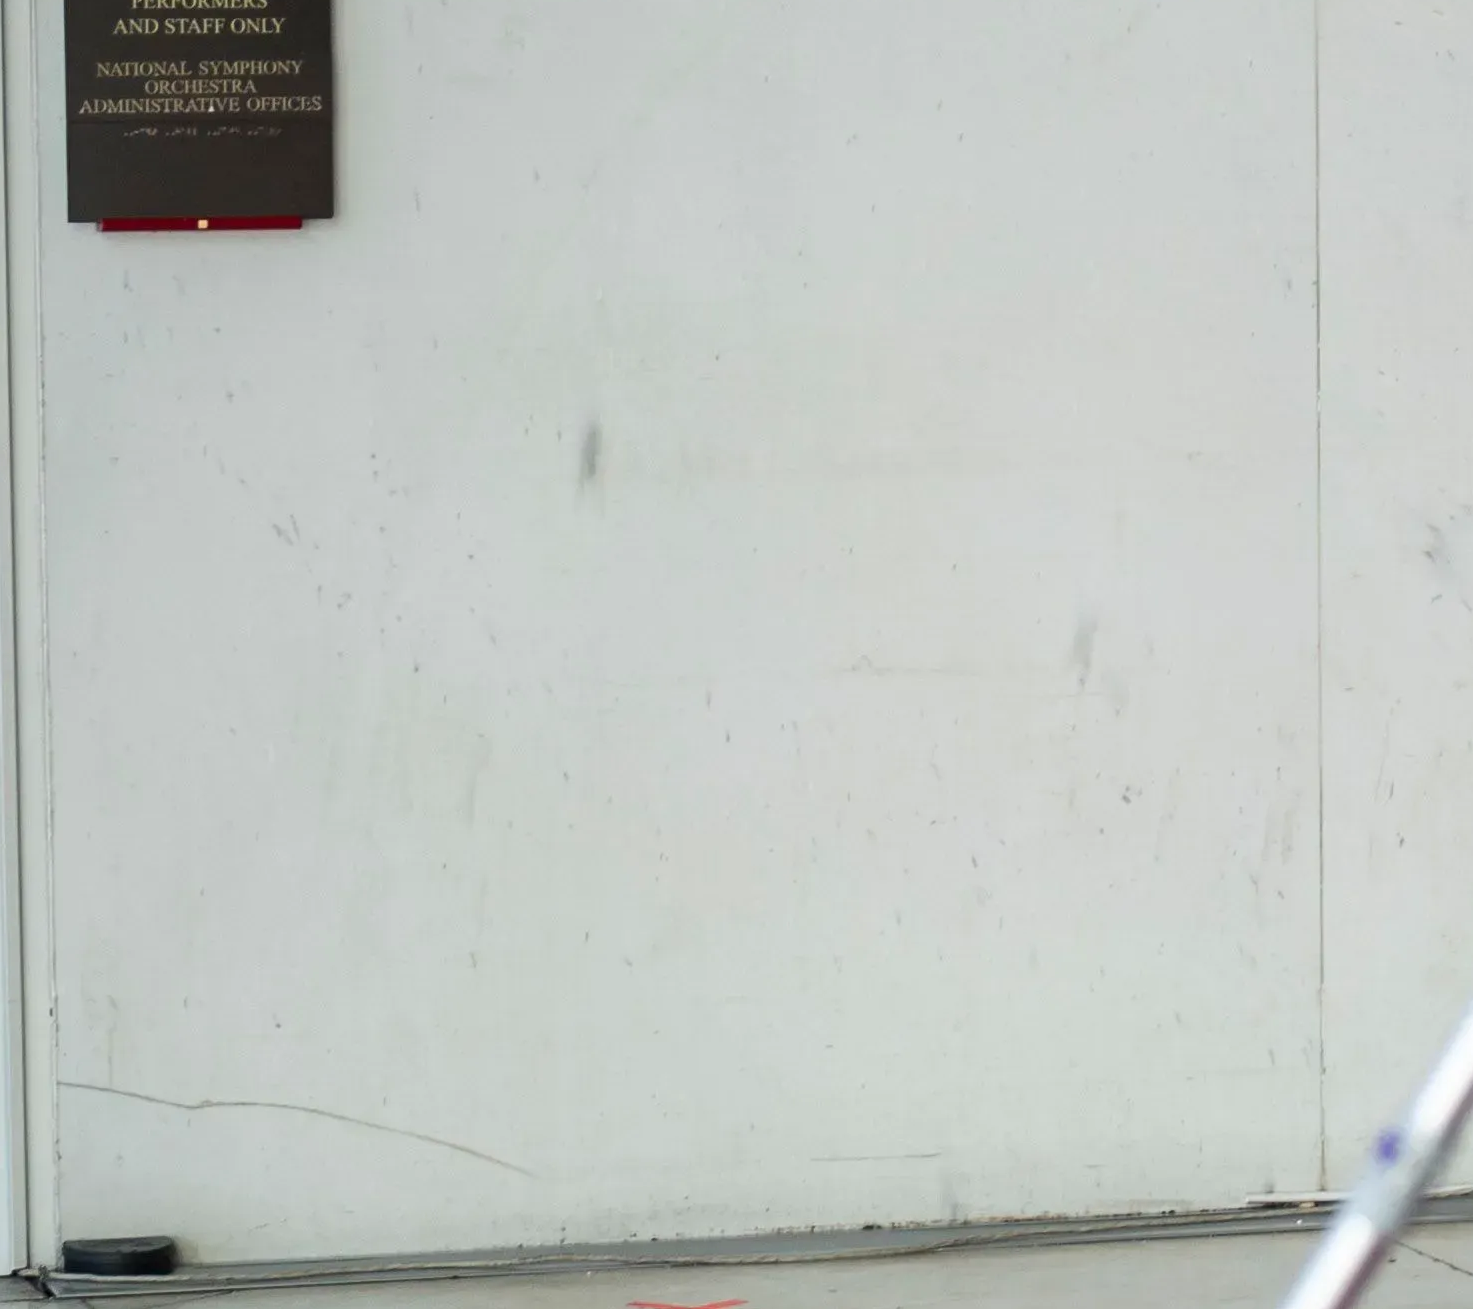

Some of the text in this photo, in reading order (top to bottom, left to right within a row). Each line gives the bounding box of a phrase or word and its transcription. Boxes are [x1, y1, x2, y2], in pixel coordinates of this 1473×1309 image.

[113, 18, 285, 34] AND STAFF ONLY
[97, 60, 303, 77] NATIONAL SYMPHONY
[144, 79, 256, 94] ORCHESTRA
[79, 96, 322, 113] ADMINISTRATIVE OFFICES
